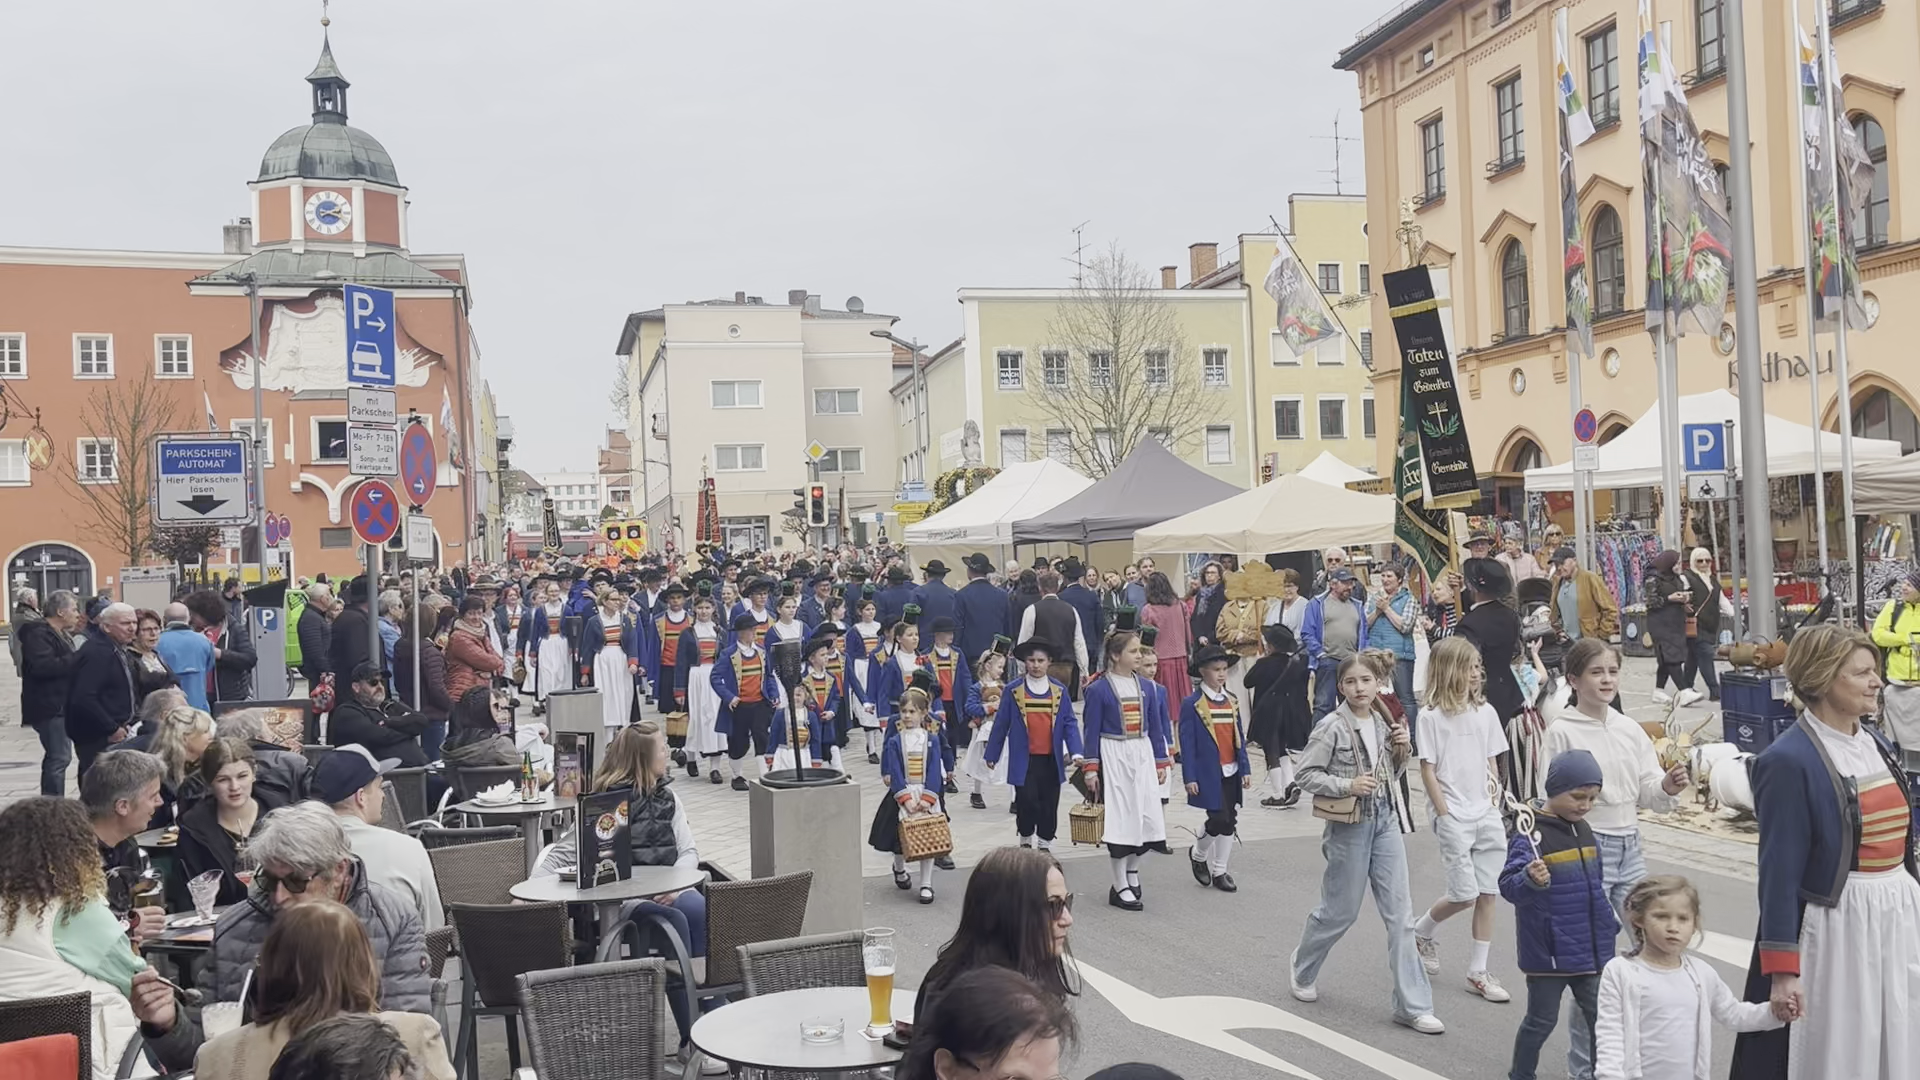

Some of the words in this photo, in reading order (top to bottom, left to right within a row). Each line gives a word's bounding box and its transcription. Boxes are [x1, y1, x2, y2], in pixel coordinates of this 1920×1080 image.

[352, 291, 374, 329] P
[1407, 348, 1444, 364] Toten
[1419, 367, 1439, 377] zum
[1728, 349, 1835, 389] Rthau
[351, 406, 394, 418] Parkschein
[352, 432, 374, 441] Mo-Fr
[353, 443, 362, 452] Sa
[1692, 429, 1715, 465] P
[166, 449, 237, 458] PARKSCHEIN-
[178, 459, 226, 468] AUTOMAT
[166, 476, 185, 484] Hier
[189, 476, 238, 484] Parkschein
[262, 609, 275, 627] P
